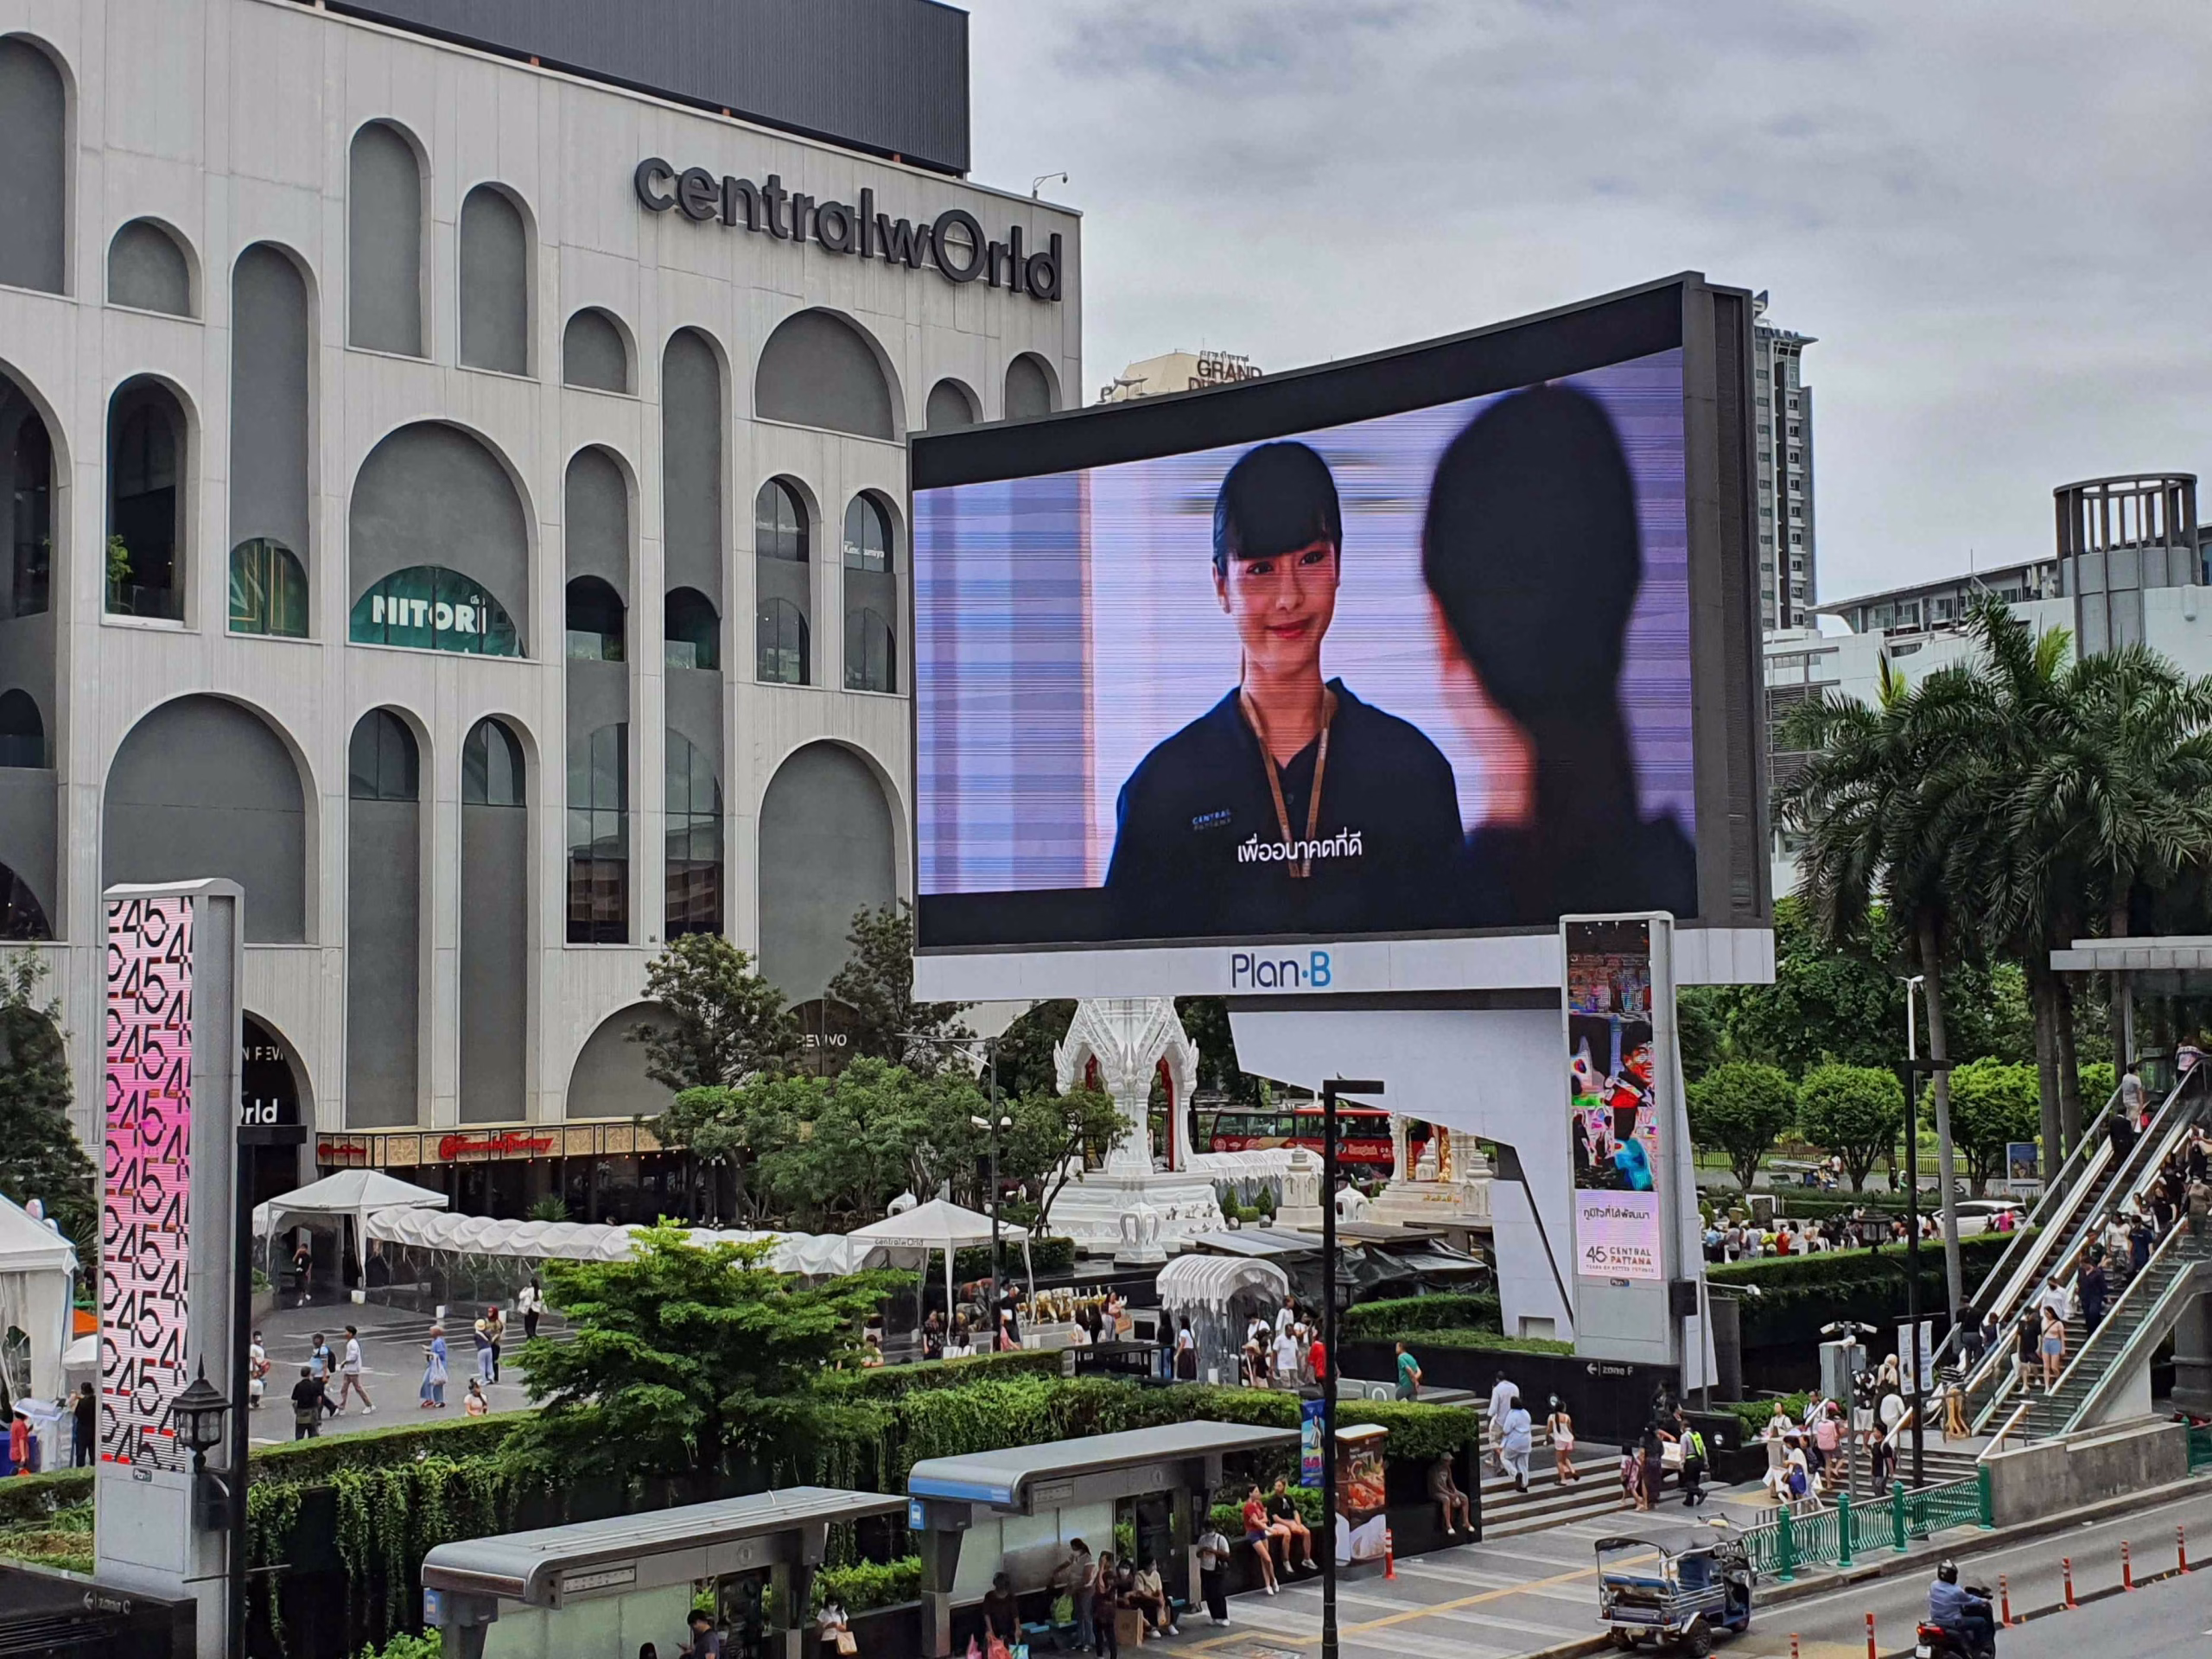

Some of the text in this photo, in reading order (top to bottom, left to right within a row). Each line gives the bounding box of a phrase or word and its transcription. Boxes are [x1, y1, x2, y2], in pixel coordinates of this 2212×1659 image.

[634, 157, 1062, 302] centralwOrld
[1198, 359, 1262, 380] GRAND
[372, 594, 486, 634] NITORI
[1237, 827, 1363, 862] เพื่ออนาคตที่ดี
[123, 899, 169, 948] 45
[122, 957, 168, 1014] 45
[120, 1024, 168, 1080] 45
[119, 1090, 167, 1147] 45
[240, 1098, 277, 1124] rld
[118, 1157, 166, 1214] 45
[118, 1223, 165, 1281] 45
[1586, 1246, 1607, 1263] 45
[1610, 1247, 1652, 1256] CENTRAL
[1611, 1255, 1652, 1265] PATTANA
[117, 1288, 164, 1348] 45
[116, 1357, 162, 1415] 45
[1627, 1366, 1634, 1376] F
[123, 1599, 130, 1615] C
